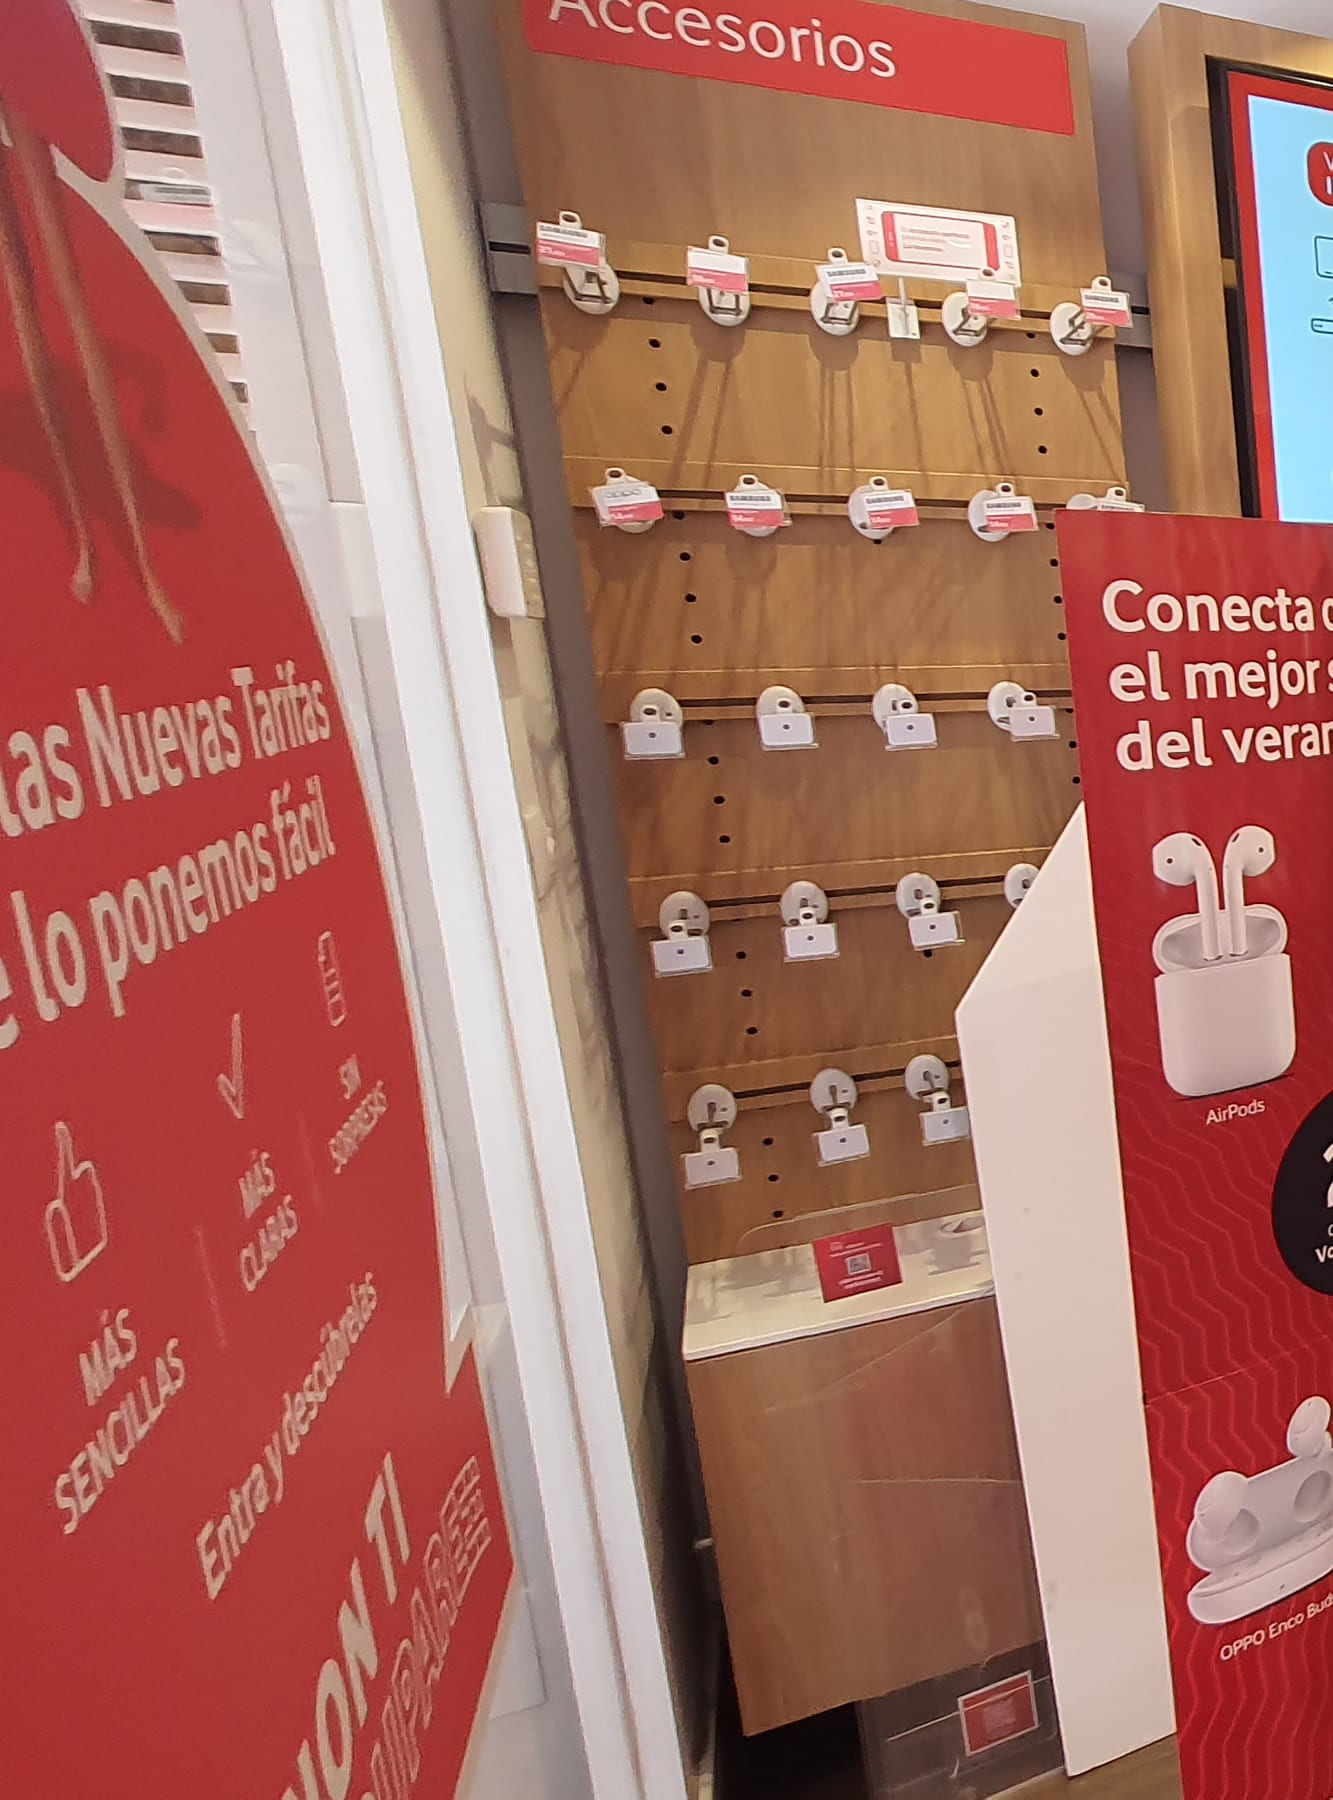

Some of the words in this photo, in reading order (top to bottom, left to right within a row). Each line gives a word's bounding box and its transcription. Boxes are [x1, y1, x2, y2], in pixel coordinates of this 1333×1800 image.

[1102, 578, 1315, 633] Conecta
[1108, 650, 1171, 703] el
[1184, 648, 1320, 709] mejor
[76, 684, 242, 808] Nuevas
[231, 660, 331, 760] Tarifas
[1115, 717, 1214, 772] del
[11, 890, 88, 1020] lo
[90, 822, 277, 1018] ponemos
[270, 774, 336, 881] fácil
[1205, 1098, 1266, 1126] AirPods
[79, 1308, 138, 1407] MÁS
[54, 1337, 186, 1536] SENCILLAS
[196, 1462, 271, 1601] Entra
[264, 1431, 284, 1507] y
[364, 1450, 411, 1606] TI
[1219, 1630, 1266, 1662] OPPO
[1269, 1611, 1305, 1640] Enco
